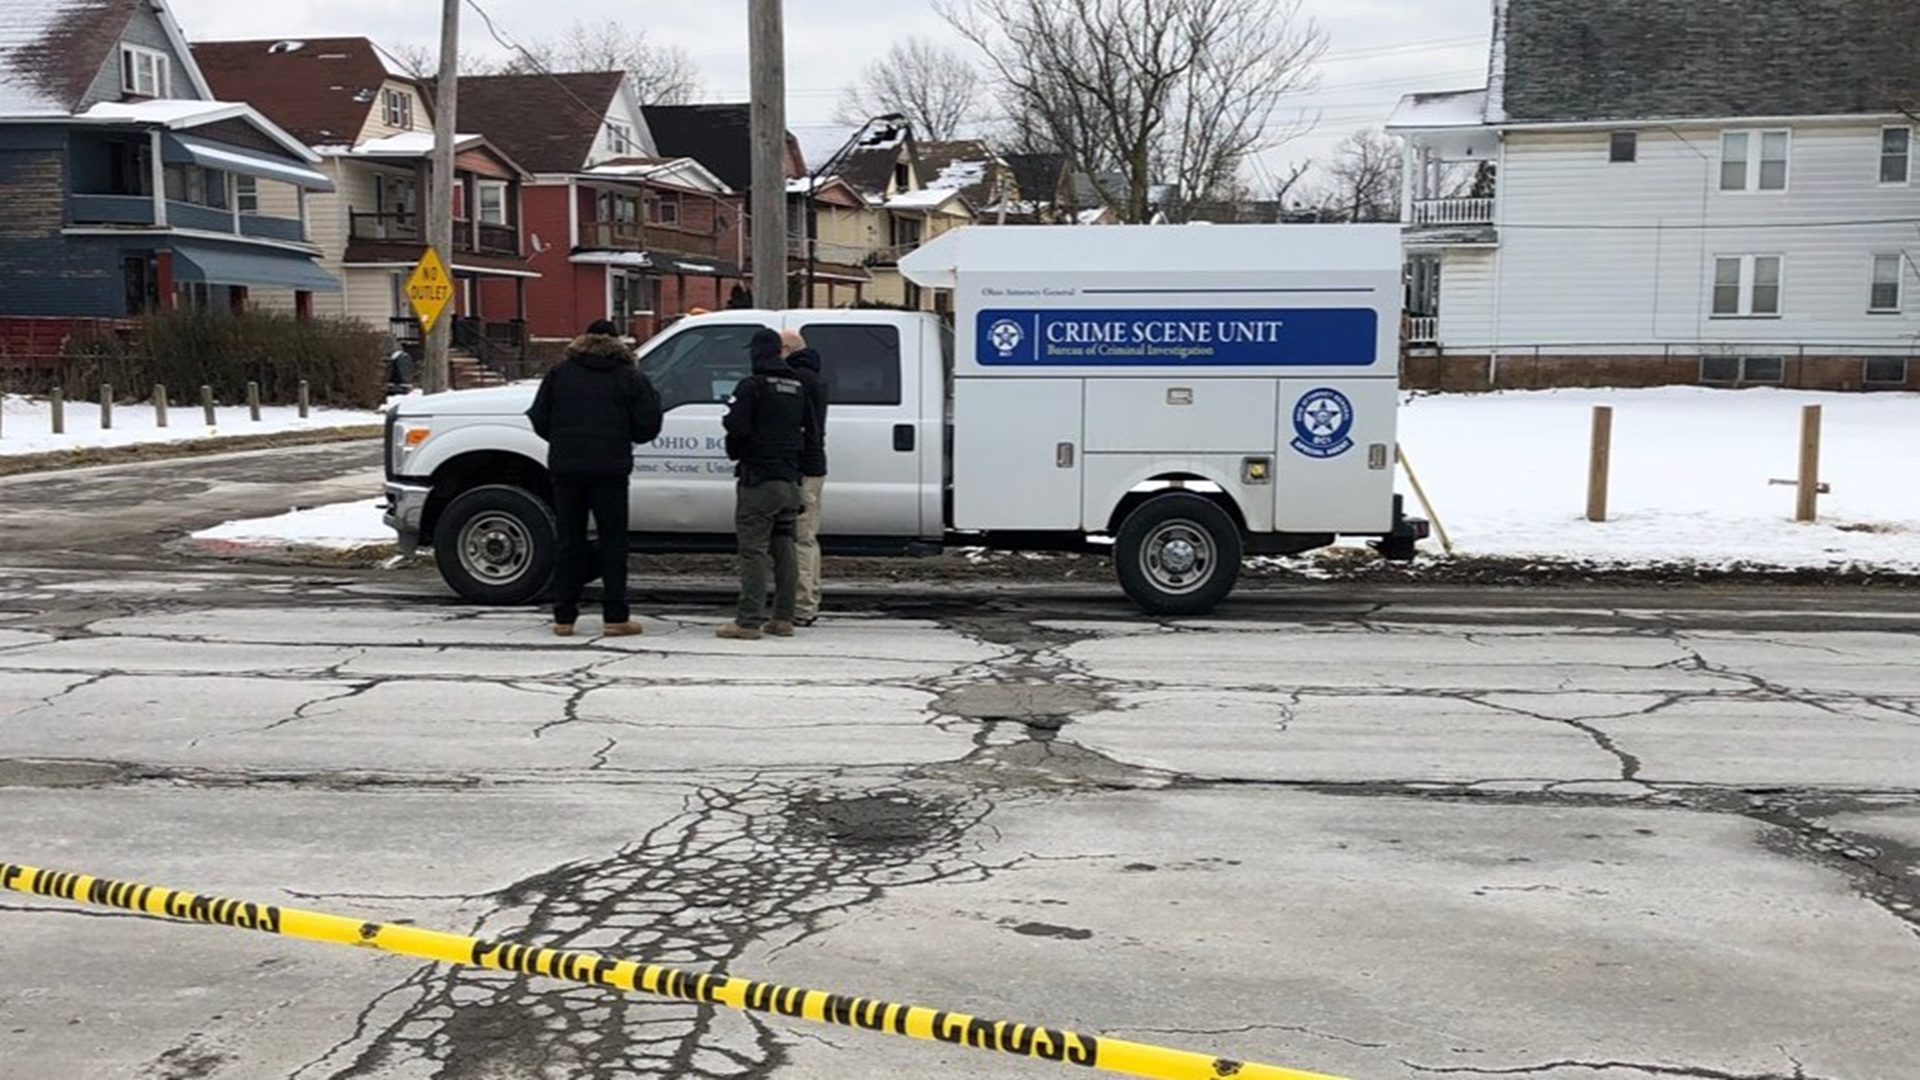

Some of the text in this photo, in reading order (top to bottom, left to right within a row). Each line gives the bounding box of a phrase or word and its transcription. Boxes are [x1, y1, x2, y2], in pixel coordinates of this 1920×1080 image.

[423, 266, 438, 281] NO
[410, 284, 448, 300] OUTLET
[1046, 321, 1127, 343] CRIME
[1132, 321, 1212, 343] SCENE
[1217, 321, 1283, 343] UNIT
[1047, 344, 1214, 359] Bureau of Criminal Investigation
[652, 437, 699, 450] OHIO
[664, 461, 700, 473] Scene
